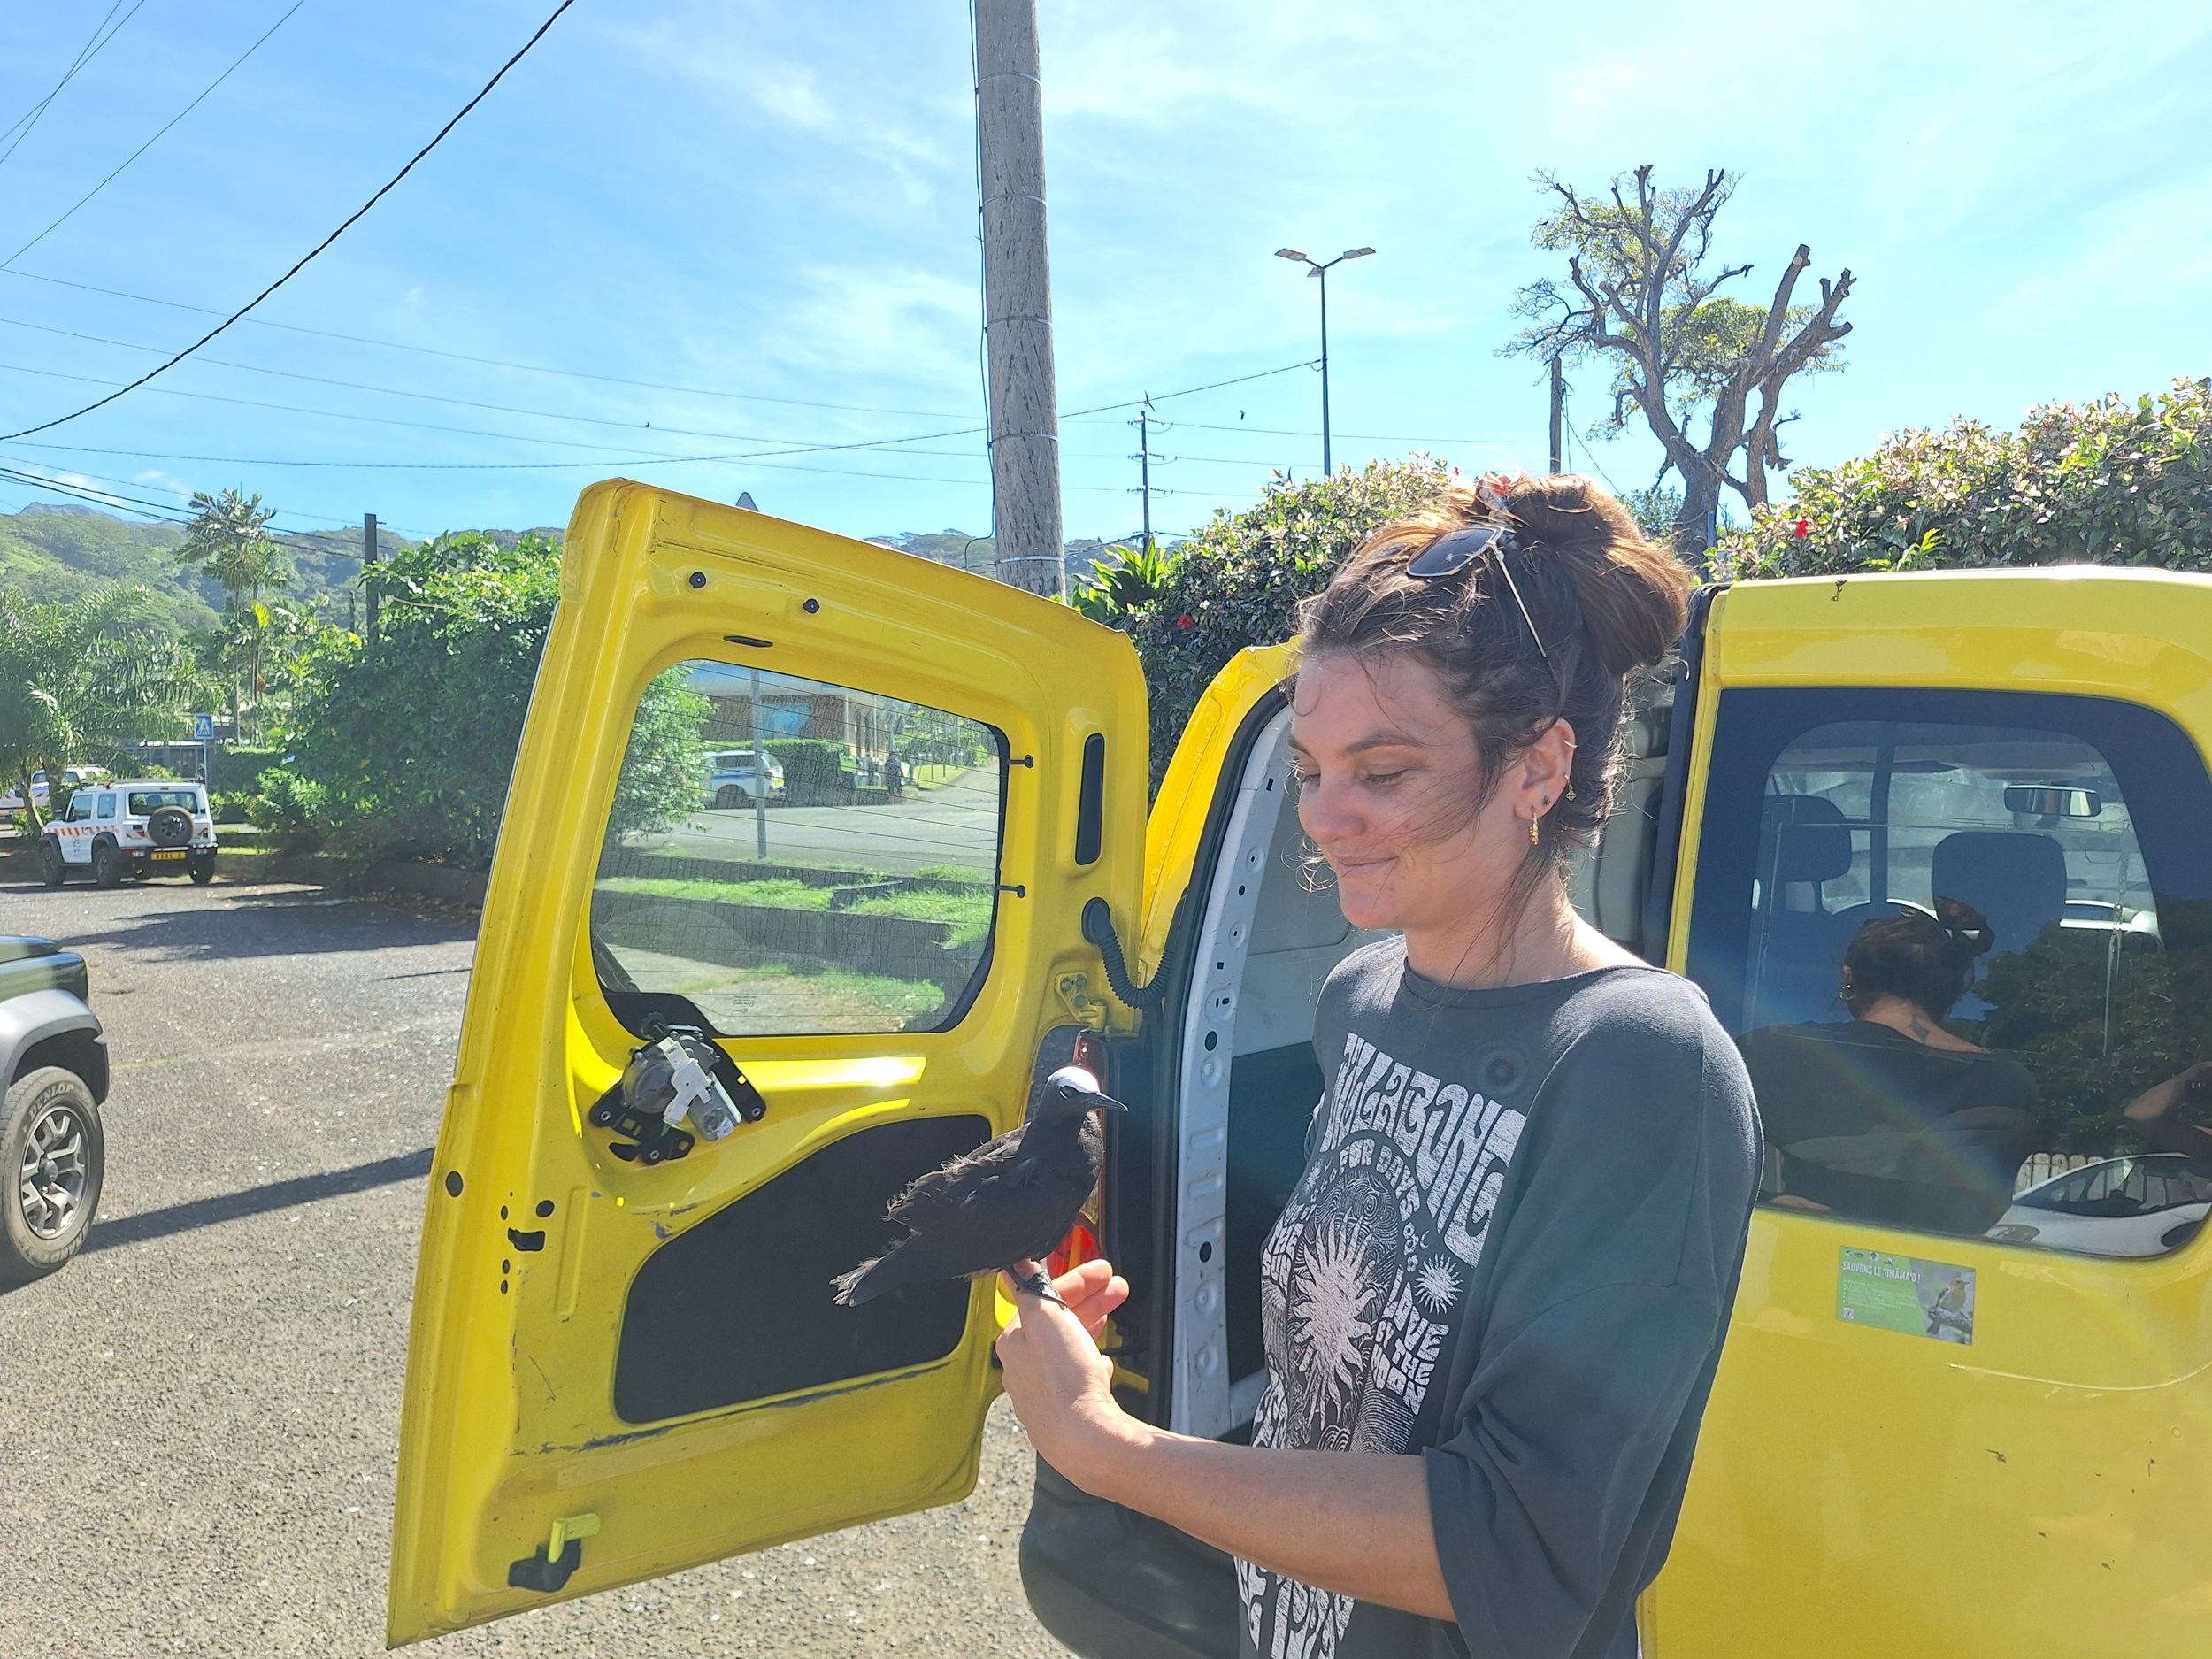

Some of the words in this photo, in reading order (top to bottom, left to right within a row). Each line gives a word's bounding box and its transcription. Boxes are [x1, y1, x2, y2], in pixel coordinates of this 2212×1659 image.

[28, 1081, 74, 1122] DUNLOP
[1339, 1138, 1376, 1176] FOR
[1376, 1145, 1421, 1222] DAYS
[1842, 1261, 1873, 1275] SAUVONS
[1873, 1266, 1881, 1277] LE
[1382, 1263, 1450, 1362] LOVE
[1371, 1343, 1426, 1416] MOON
[1375, 1320, 1395, 1348] BY
[1392, 1338, 1435, 1386] THE
